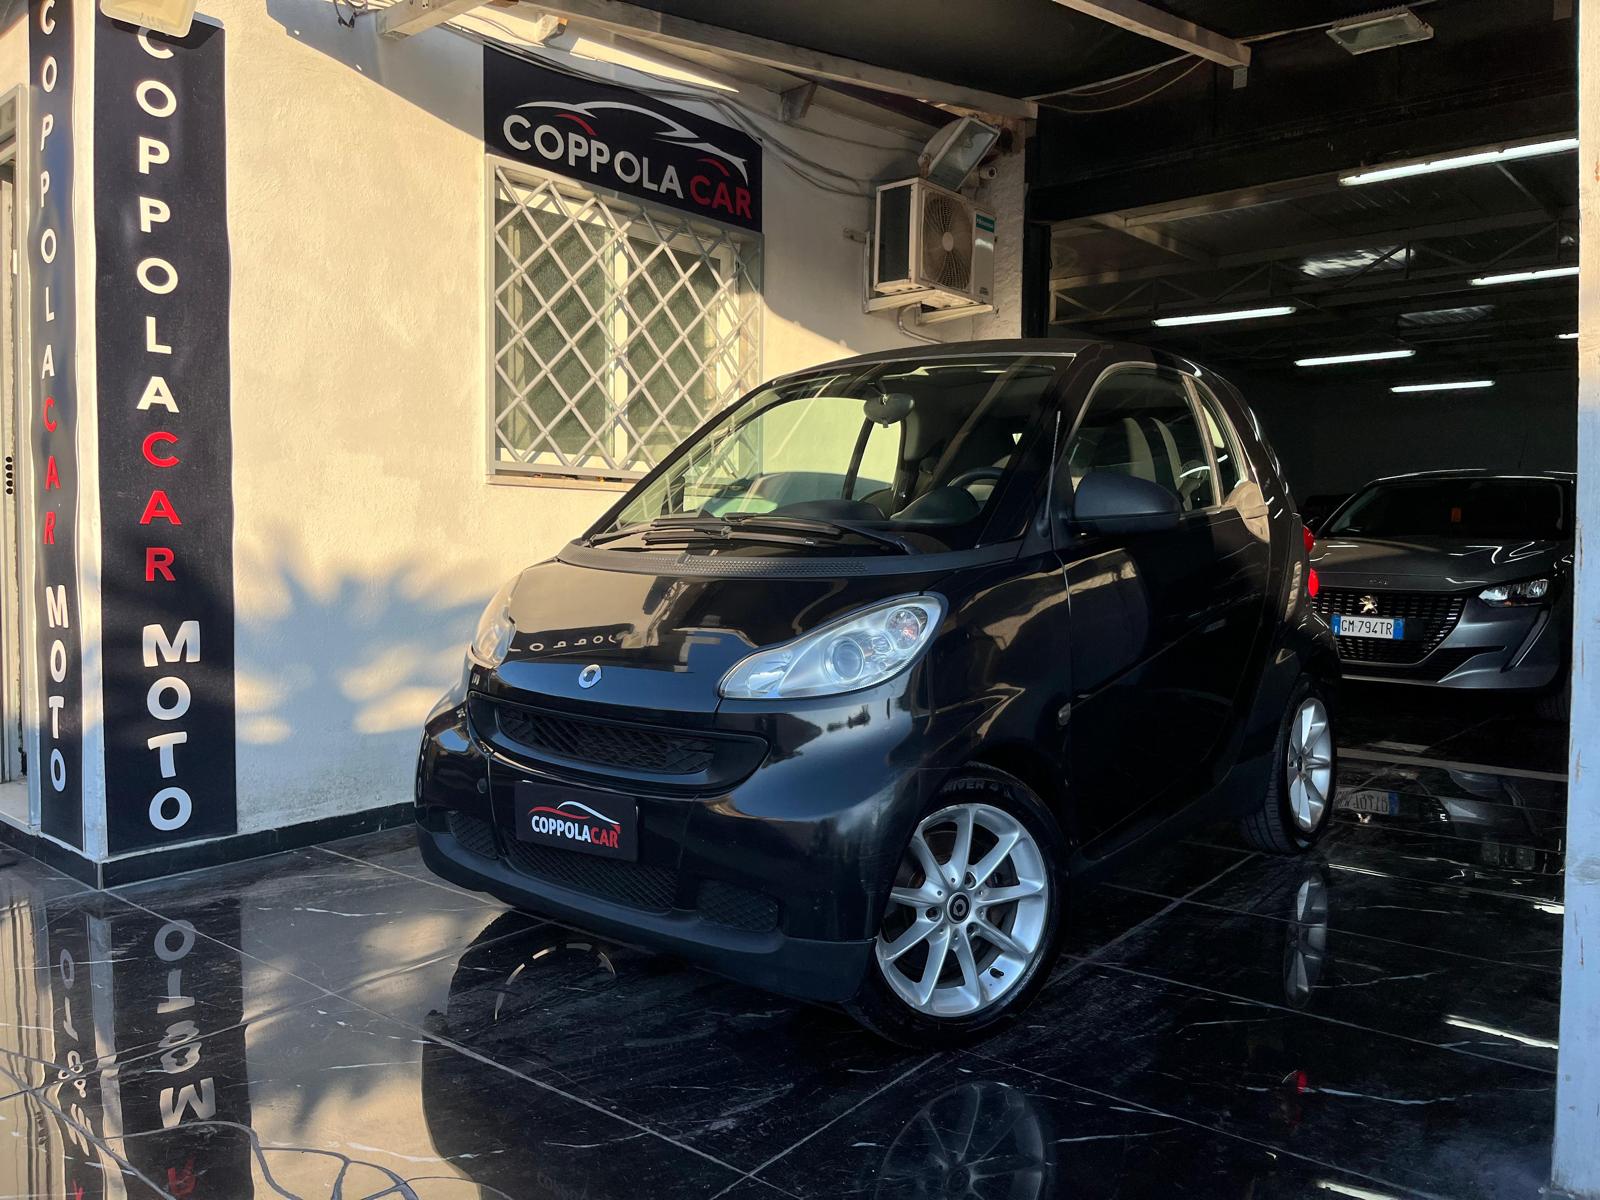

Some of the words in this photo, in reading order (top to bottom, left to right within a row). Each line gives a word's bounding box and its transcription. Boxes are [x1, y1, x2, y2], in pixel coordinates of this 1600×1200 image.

[502, 114, 684, 199] COPPOLA
[689, 175, 753, 219] CAR
[45, 584, 70, 792] MOTO
[142, 620, 201, 831] MOTO
